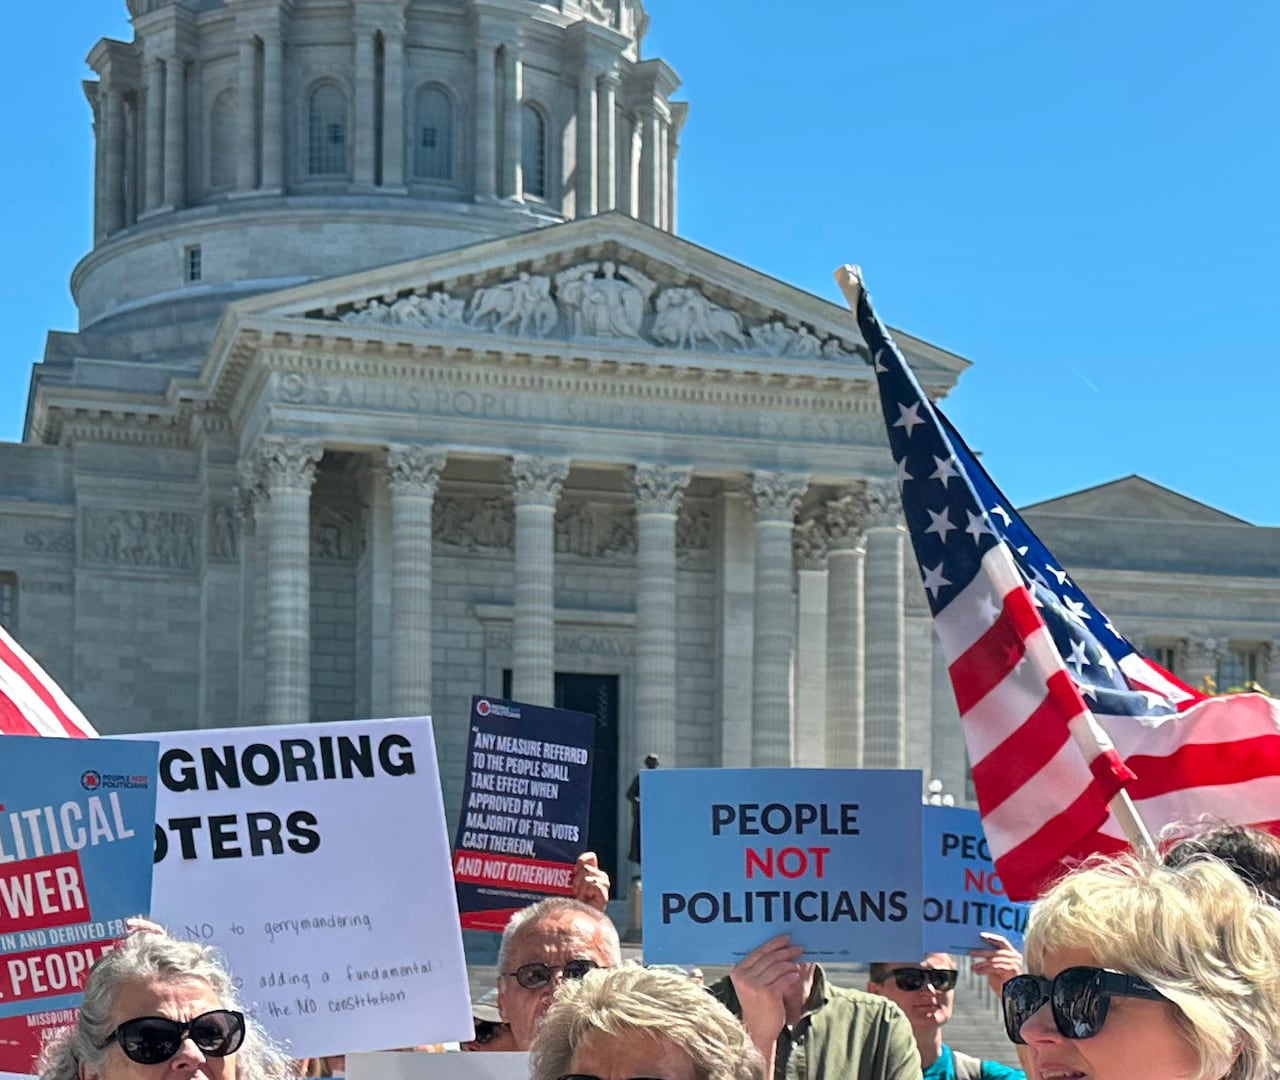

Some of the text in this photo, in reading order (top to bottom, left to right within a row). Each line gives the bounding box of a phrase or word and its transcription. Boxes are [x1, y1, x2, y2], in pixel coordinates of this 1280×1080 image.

[497, 735, 541, 758] MEASURE
[543, 742, 588, 766] REFERRED
[473, 752, 569, 782] TO THE PEOPLE SHALL
[471, 772, 558, 799] TAKE EFFECT WHEN
[469, 791, 520, 814] APPROVED
[466, 812, 518, 835] MAJORITY
[533, 821, 550, 838] THE
[551, 824, 579, 842] VOTES
[711, 803, 860, 837] PEOPLE
[462, 831, 488, 850] CAST
[456, 857, 481, 877] AND
[482, 861, 505, 880] NOT
[744, 846, 831, 880] NOT
[661, 889, 908, 925] POLITICIANS
[185, 913, 372, 942] NO to gerrymandering
[259, 971, 310, 988] adding
[346, 960, 432, 982] fundamental
